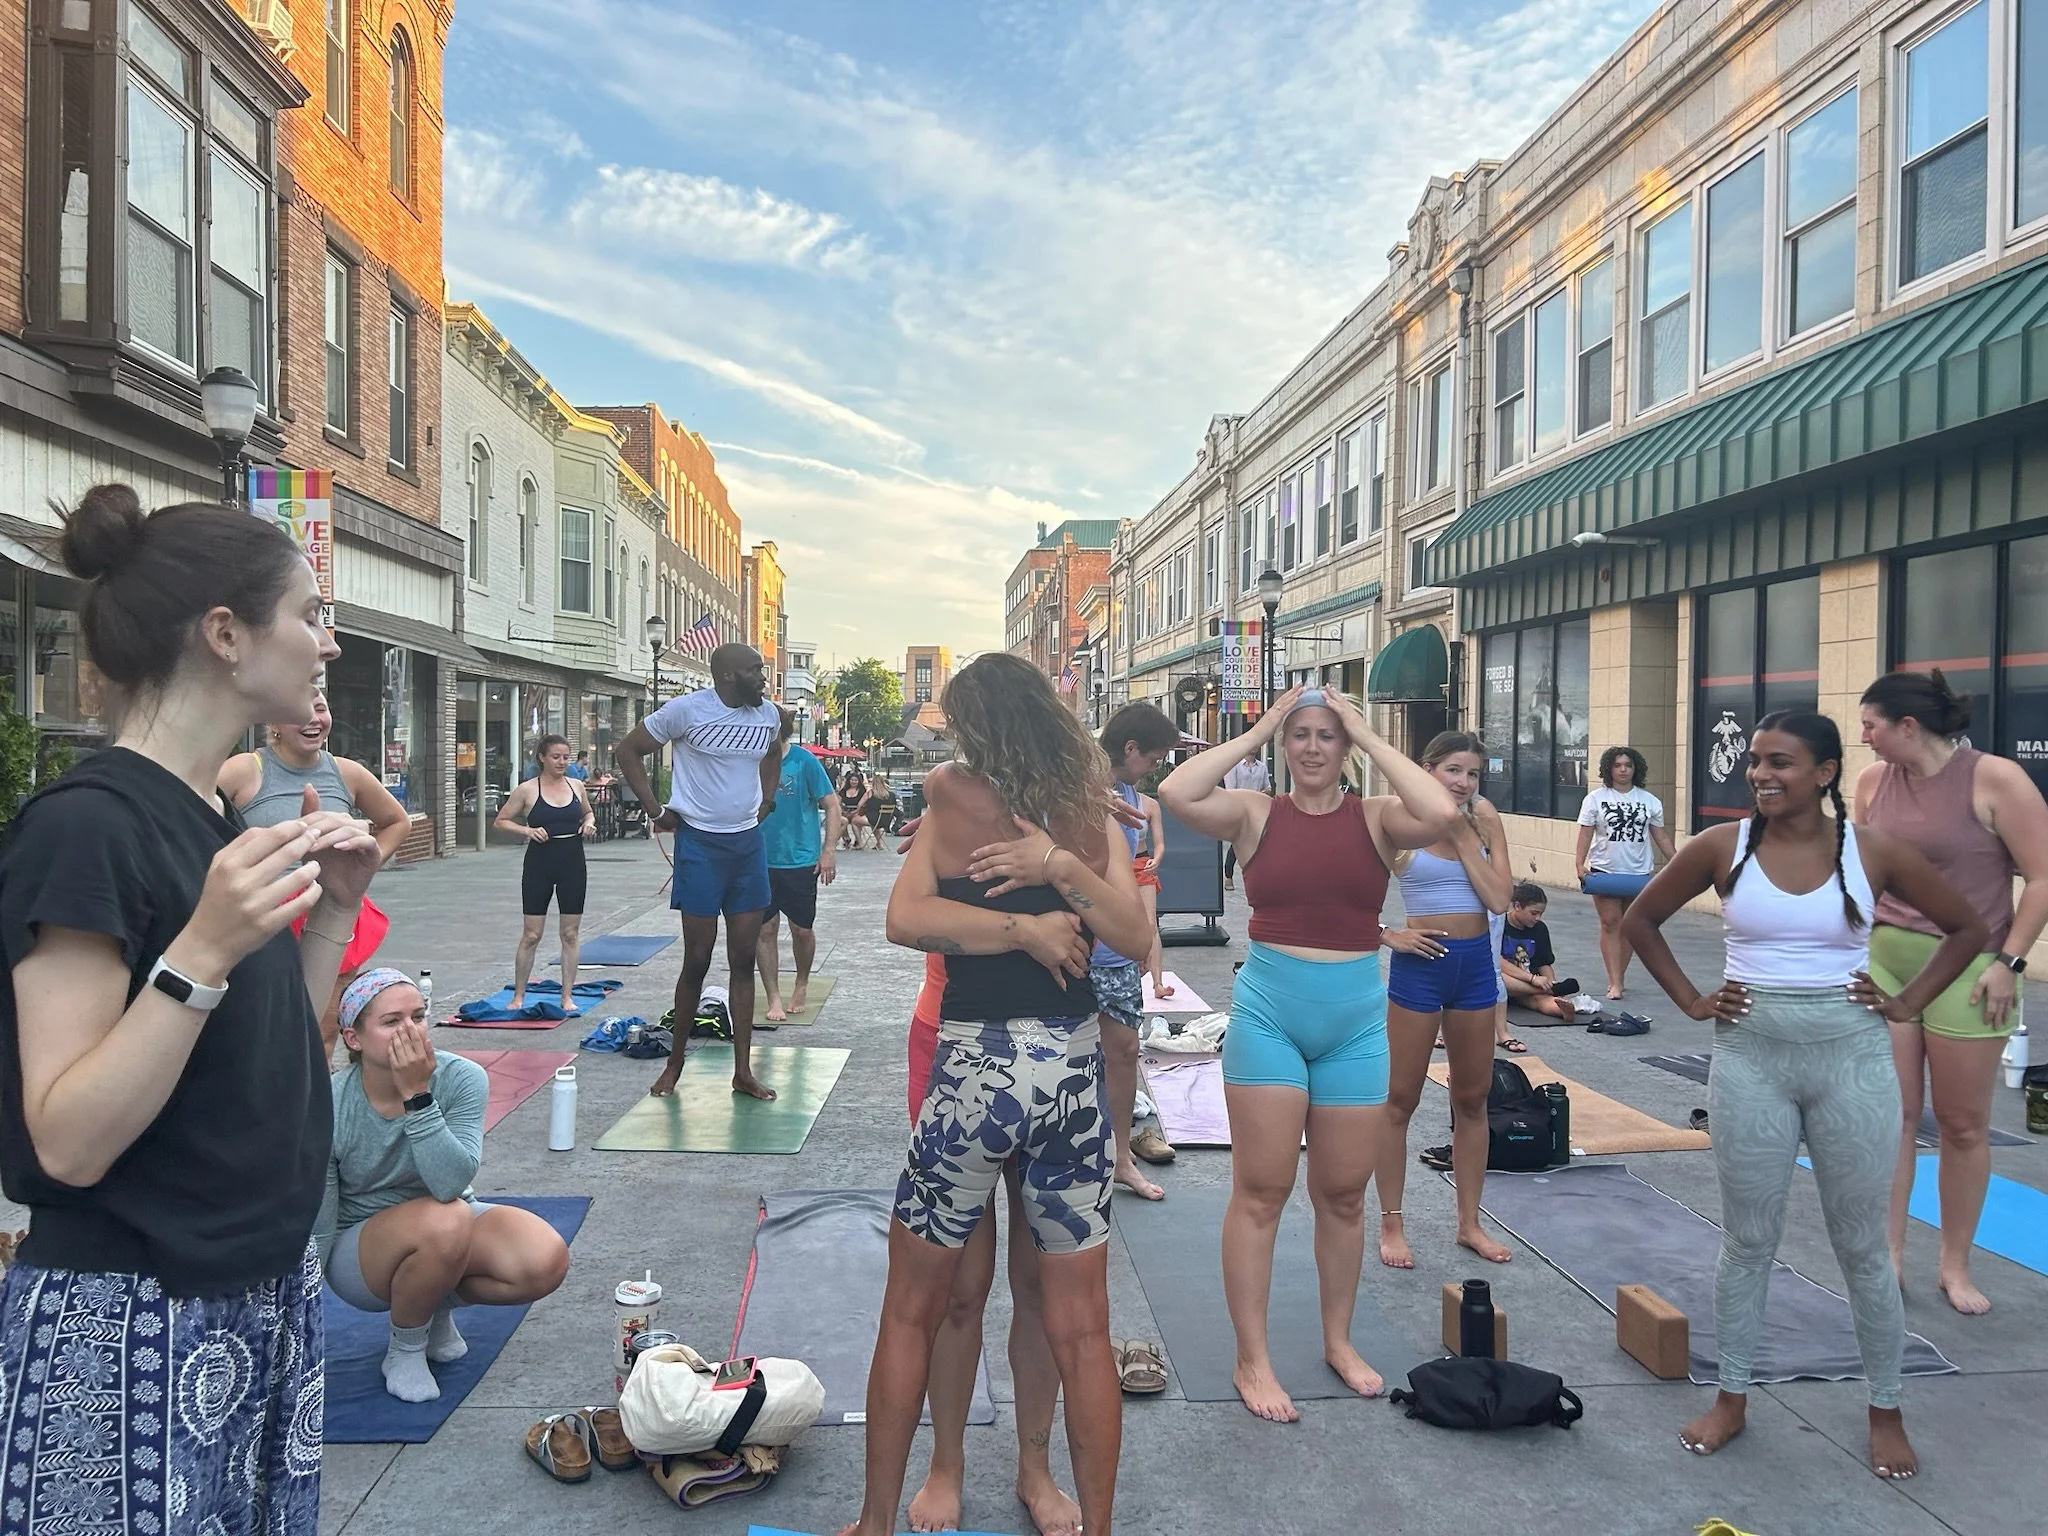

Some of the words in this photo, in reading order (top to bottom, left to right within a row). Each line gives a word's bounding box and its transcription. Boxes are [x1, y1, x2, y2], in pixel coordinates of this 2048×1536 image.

[273, 521, 328, 540] OVE
[1225, 647, 1259, 656] LOVE
[1225, 665, 1259, 673] PRIDE
[1492, 681, 1503, 693] THE
[1564, 749, 1587, 757] NAVY.COM
[1015, 1035, 1041, 1043] YOGA
[1009, 1043, 1047, 1051] ODYSSEY
